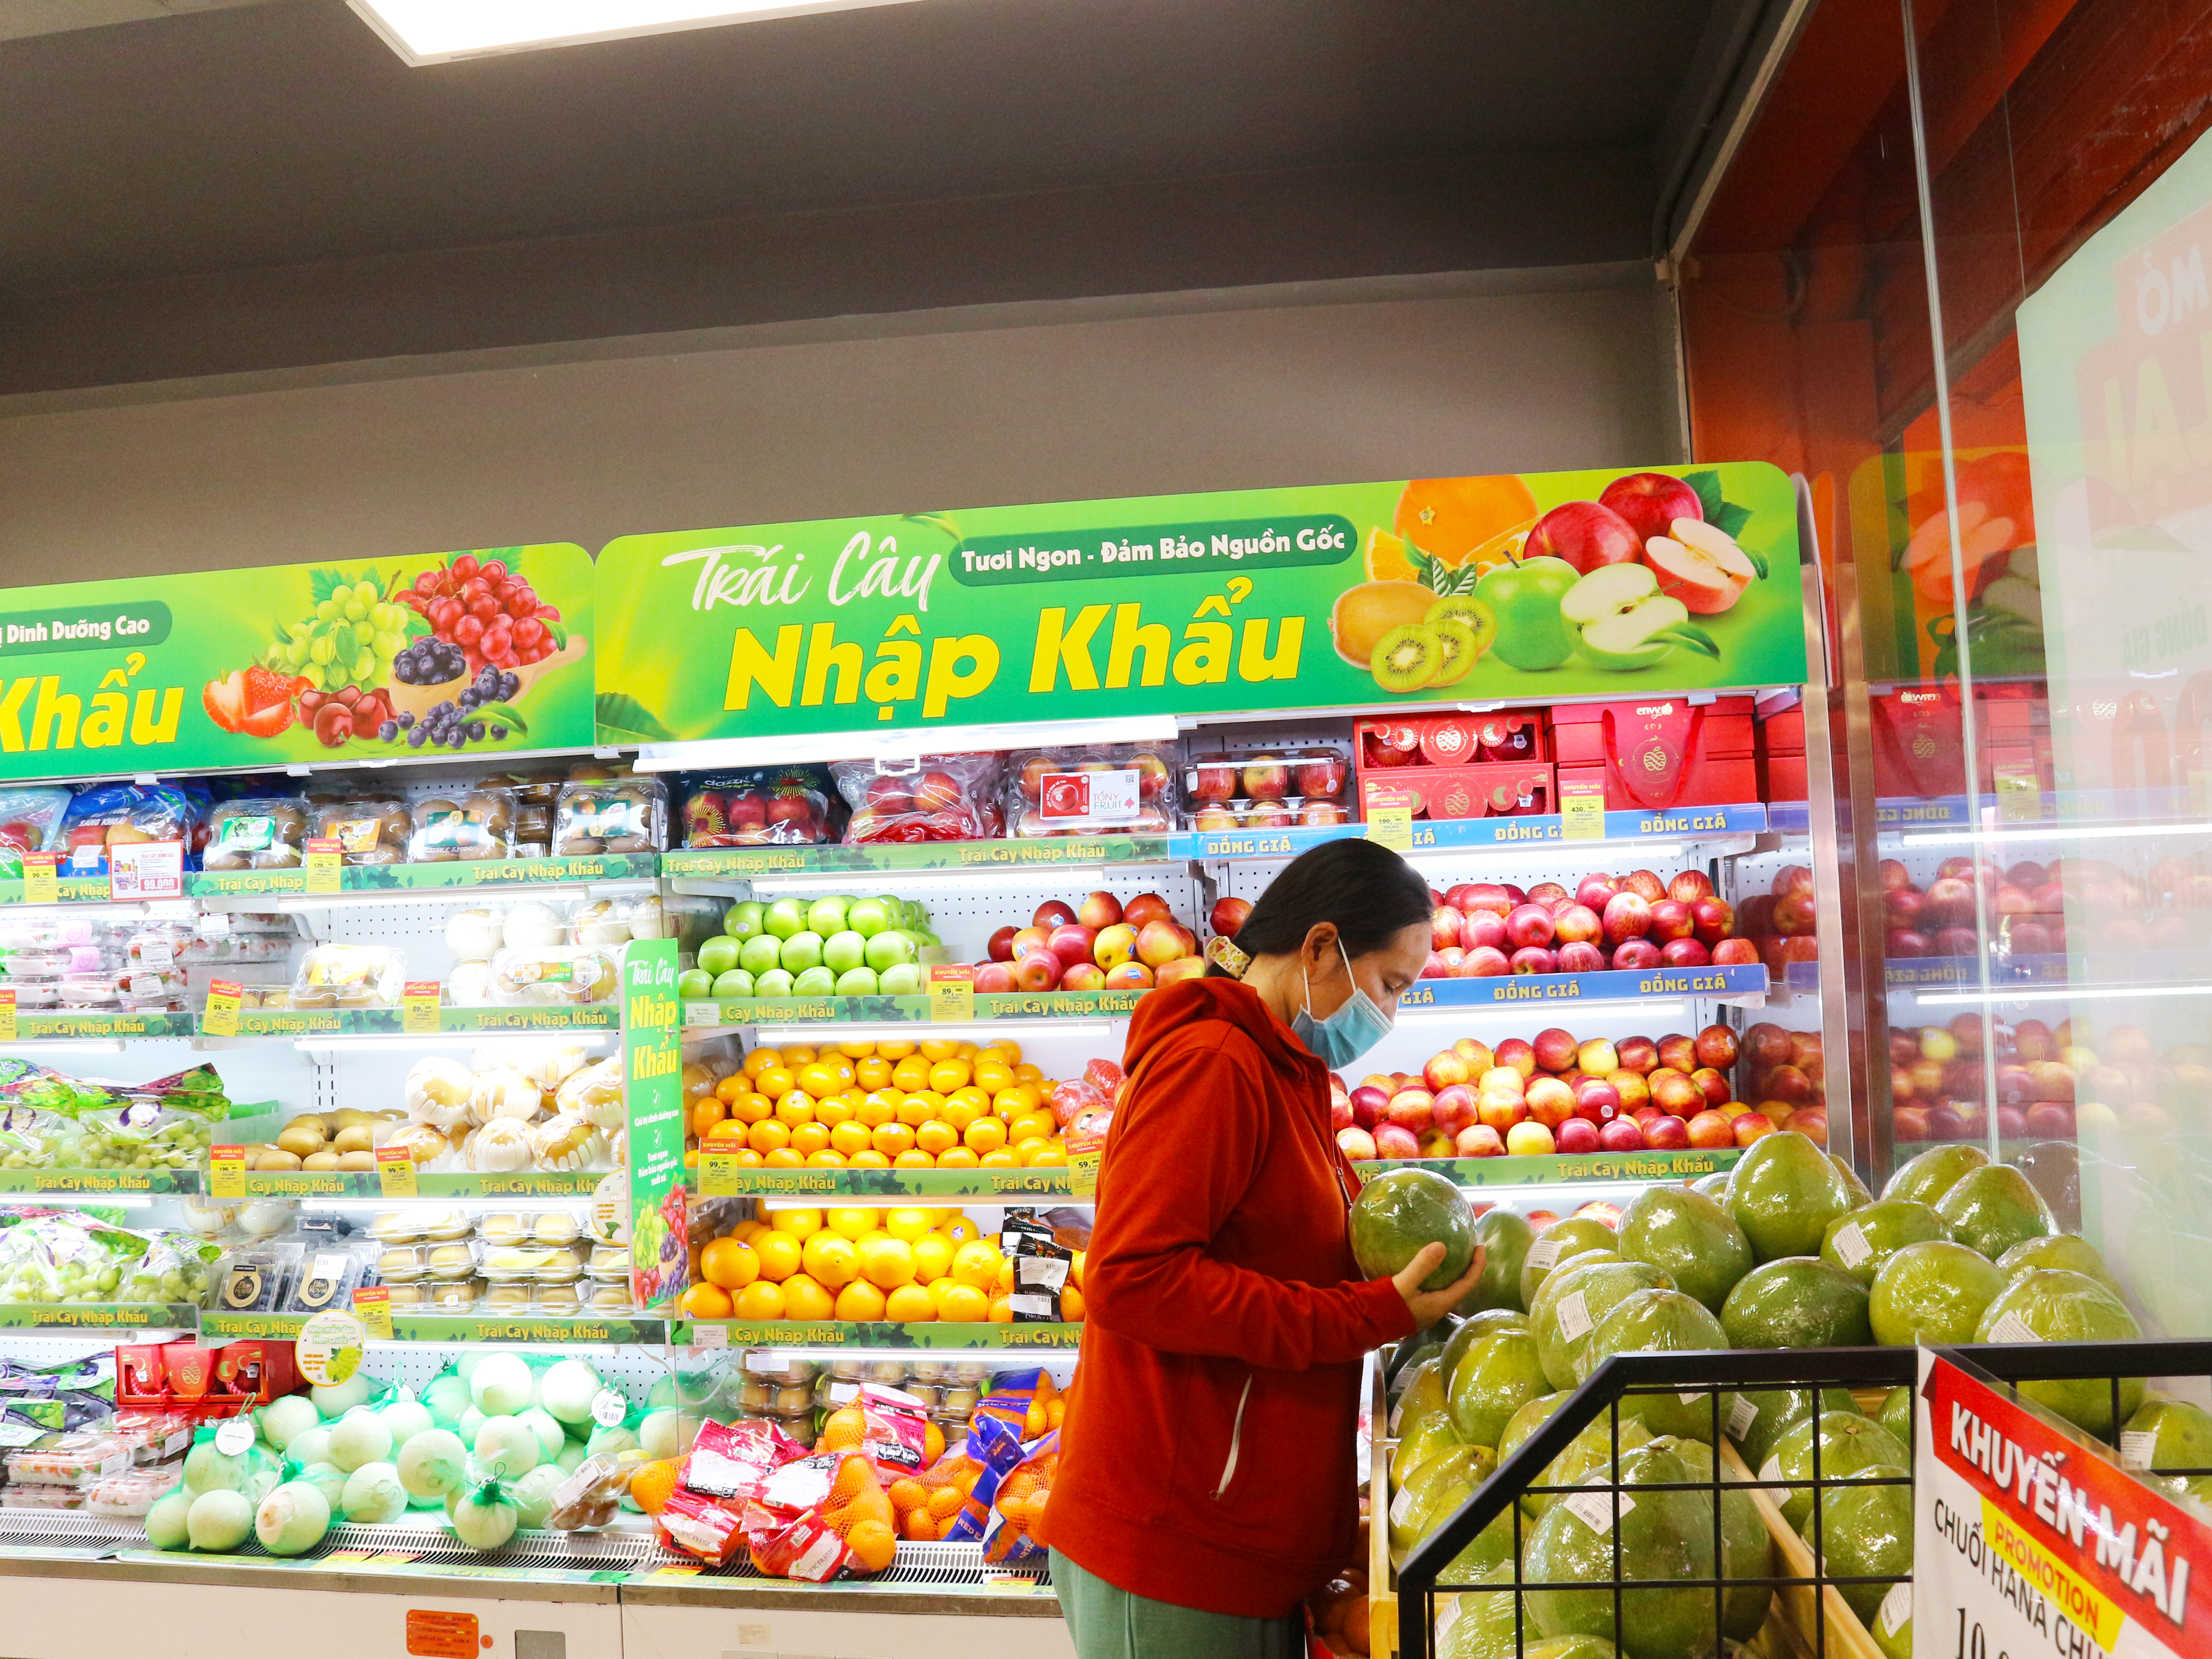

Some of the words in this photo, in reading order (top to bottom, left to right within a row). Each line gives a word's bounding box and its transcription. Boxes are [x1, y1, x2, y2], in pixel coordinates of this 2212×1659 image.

[961, 549, 1012, 573] Tươi
[1018, 545, 1081, 572] Ngon
[1100, 538, 1153, 564] Đảm
[1160, 535, 1206, 560] Bảo
[1211, 528, 1291, 559] Nguồn
[1296, 524, 1345, 552] Gốc
[662, 544, 813, 611] Trái
[828, 531, 941, 612] Cây
[7, 622, 48, 644] Dinh
[52, 618, 111, 641] Dưỡng
[115, 615, 150, 636] Cao
[723, 613, 1000, 720] Nhập
[1028, 576, 1306, 693] Khẩu
[1636, 706, 1662, 719] envy
[1093, 791, 1119, 801] TÓNY
[1094, 800, 1122, 809] FRUIT
[1494, 820, 1543, 841] ĐỒNG
[1640, 812, 1689, 833] ĐỒNG
[1693, 812, 1727, 830] GIÁ
[1207, 834, 1255, 854] ĐỒNG
[1259, 835, 1291, 852] GIÁ
[1414, 828, 1435, 845] IÁ
[959, 847, 987, 862] Trái
[990, 846, 1018, 863] Cây
[1022, 845, 1062, 862] Nhập
[1066, 841, 1105, 859] Khẩu
[473, 866, 498, 880] Trái
[501, 865, 526, 881] Cây
[529, 863, 566, 879] Nhập
[568, 859, 604, 876] Khẩu
[667, 858, 693, 873] Trái
[697, 857, 722, 874] Cây
[726, 856, 765, 872] Nhập
[769, 851, 805, 869] Khẩu
[57, 885, 77, 900] Cây
[218, 877, 241, 891] Trái
[244, 877, 267, 892] Cây
[270, 875, 304, 890] Nhập
[626, 960, 653, 986] Trái
[656, 957, 674, 988] Cây
[1494, 980, 1542, 1000] ĐỒNG
[1547, 980, 1580, 998] GIÁ
[1640, 973, 1688, 993] ĐỒNG
[1693, 973, 1727, 991] GIÁ
[990, 998, 1019, 1014] Trái
[1022, 998, 1050, 1016] Cây
[1054, 998, 1095, 1016] Nhập
[1099, 993, 1138, 1011] Khẩu
[1401, 987, 1434, 1005] GIÁ
[477, 1013, 502, 1027] Trái
[505, 1012, 529, 1029] Cây
[532, 1011, 570, 1029] Nhập
[572, 1008, 608, 1025] Khẩu
[630, 992, 677, 1033] Nhập
[726, 1006, 752, 1022] Cây
[756, 1005, 794, 1022] Nhập
[798, 1001, 835, 1018] Khẩu
[30, 1022, 52, 1034] Trái
[55, 1021, 76, 1036] Cây
[79, 1021, 111, 1035] Nhập
[114, 1018, 145, 1033] Khẩu
[247, 1018, 269, 1034] Cây
[272, 1017, 306, 1033] Nhập
[309, 1014, 342, 1030] Khẩu
[633, 1034, 677, 1081] Khẩu
[657, 1150, 668, 1160] ngon
[1068, 1141, 1091, 1149] KHUYẾN
[1557, 1162, 1588, 1178] Trái
[1592, 1161, 1621, 1179] Cây
[1625, 1159, 1669, 1178] Nhập
[1672, 1155, 1714, 1173] Khẩu
[34, 1176, 57, 1189] Trái
[60, 1176, 81, 1191] Cây
[84, 1176, 117, 1191] Nhập
[119, 1174, 151, 1189] Khẩu
[250, 1179, 272, 1195] Cây
[275, 1179, 309, 1195] Nhập
[312, 1177, 345, 1192] Khẩu
[480, 1179, 505, 1192] Trái
[509, 1178, 533, 1195] Cây
[536, 1179, 573, 1195] Nhập
[756, 1176, 794, 1192] Nhập
[799, 1173, 836, 1189] Khẩu
[991, 1175, 1020, 1190] Trái
[1023, 1176, 1051, 1192] Cây
[32, 1310, 54, 1323] Trái
[57, 1310, 79, 1325] Cây
[82, 1310, 115, 1325] Nhập
[117, 1308, 148, 1323] Khẩu
[219, 1320, 243, 1334] Trái
[246, 1321, 268, 1336] Cây
[477, 1323, 502, 1337] Trái
[505, 1324, 529, 1340] Cây
[533, 1324, 570, 1341] Nhập
[573, 1322, 609, 1339] Khẩu
[734, 1327, 761, 1345] Cây
[765, 1328, 803, 1345] Nhập
[807, 1325, 845, 1342] Khẩu
[1000, 1328, 1028, 1344] Trái
[1032, 1329, 1059, 1346] Cây
[1950, 1400, 2088, 1548] KHUYẾN
[2095, 1504, 2190, 1627] MÃI
[692, 1536, 710, 1547] FRESH
[817, 1547, 834, 1567] FRESH
[1995, 1519, 2099, 1631] PROMOTION
